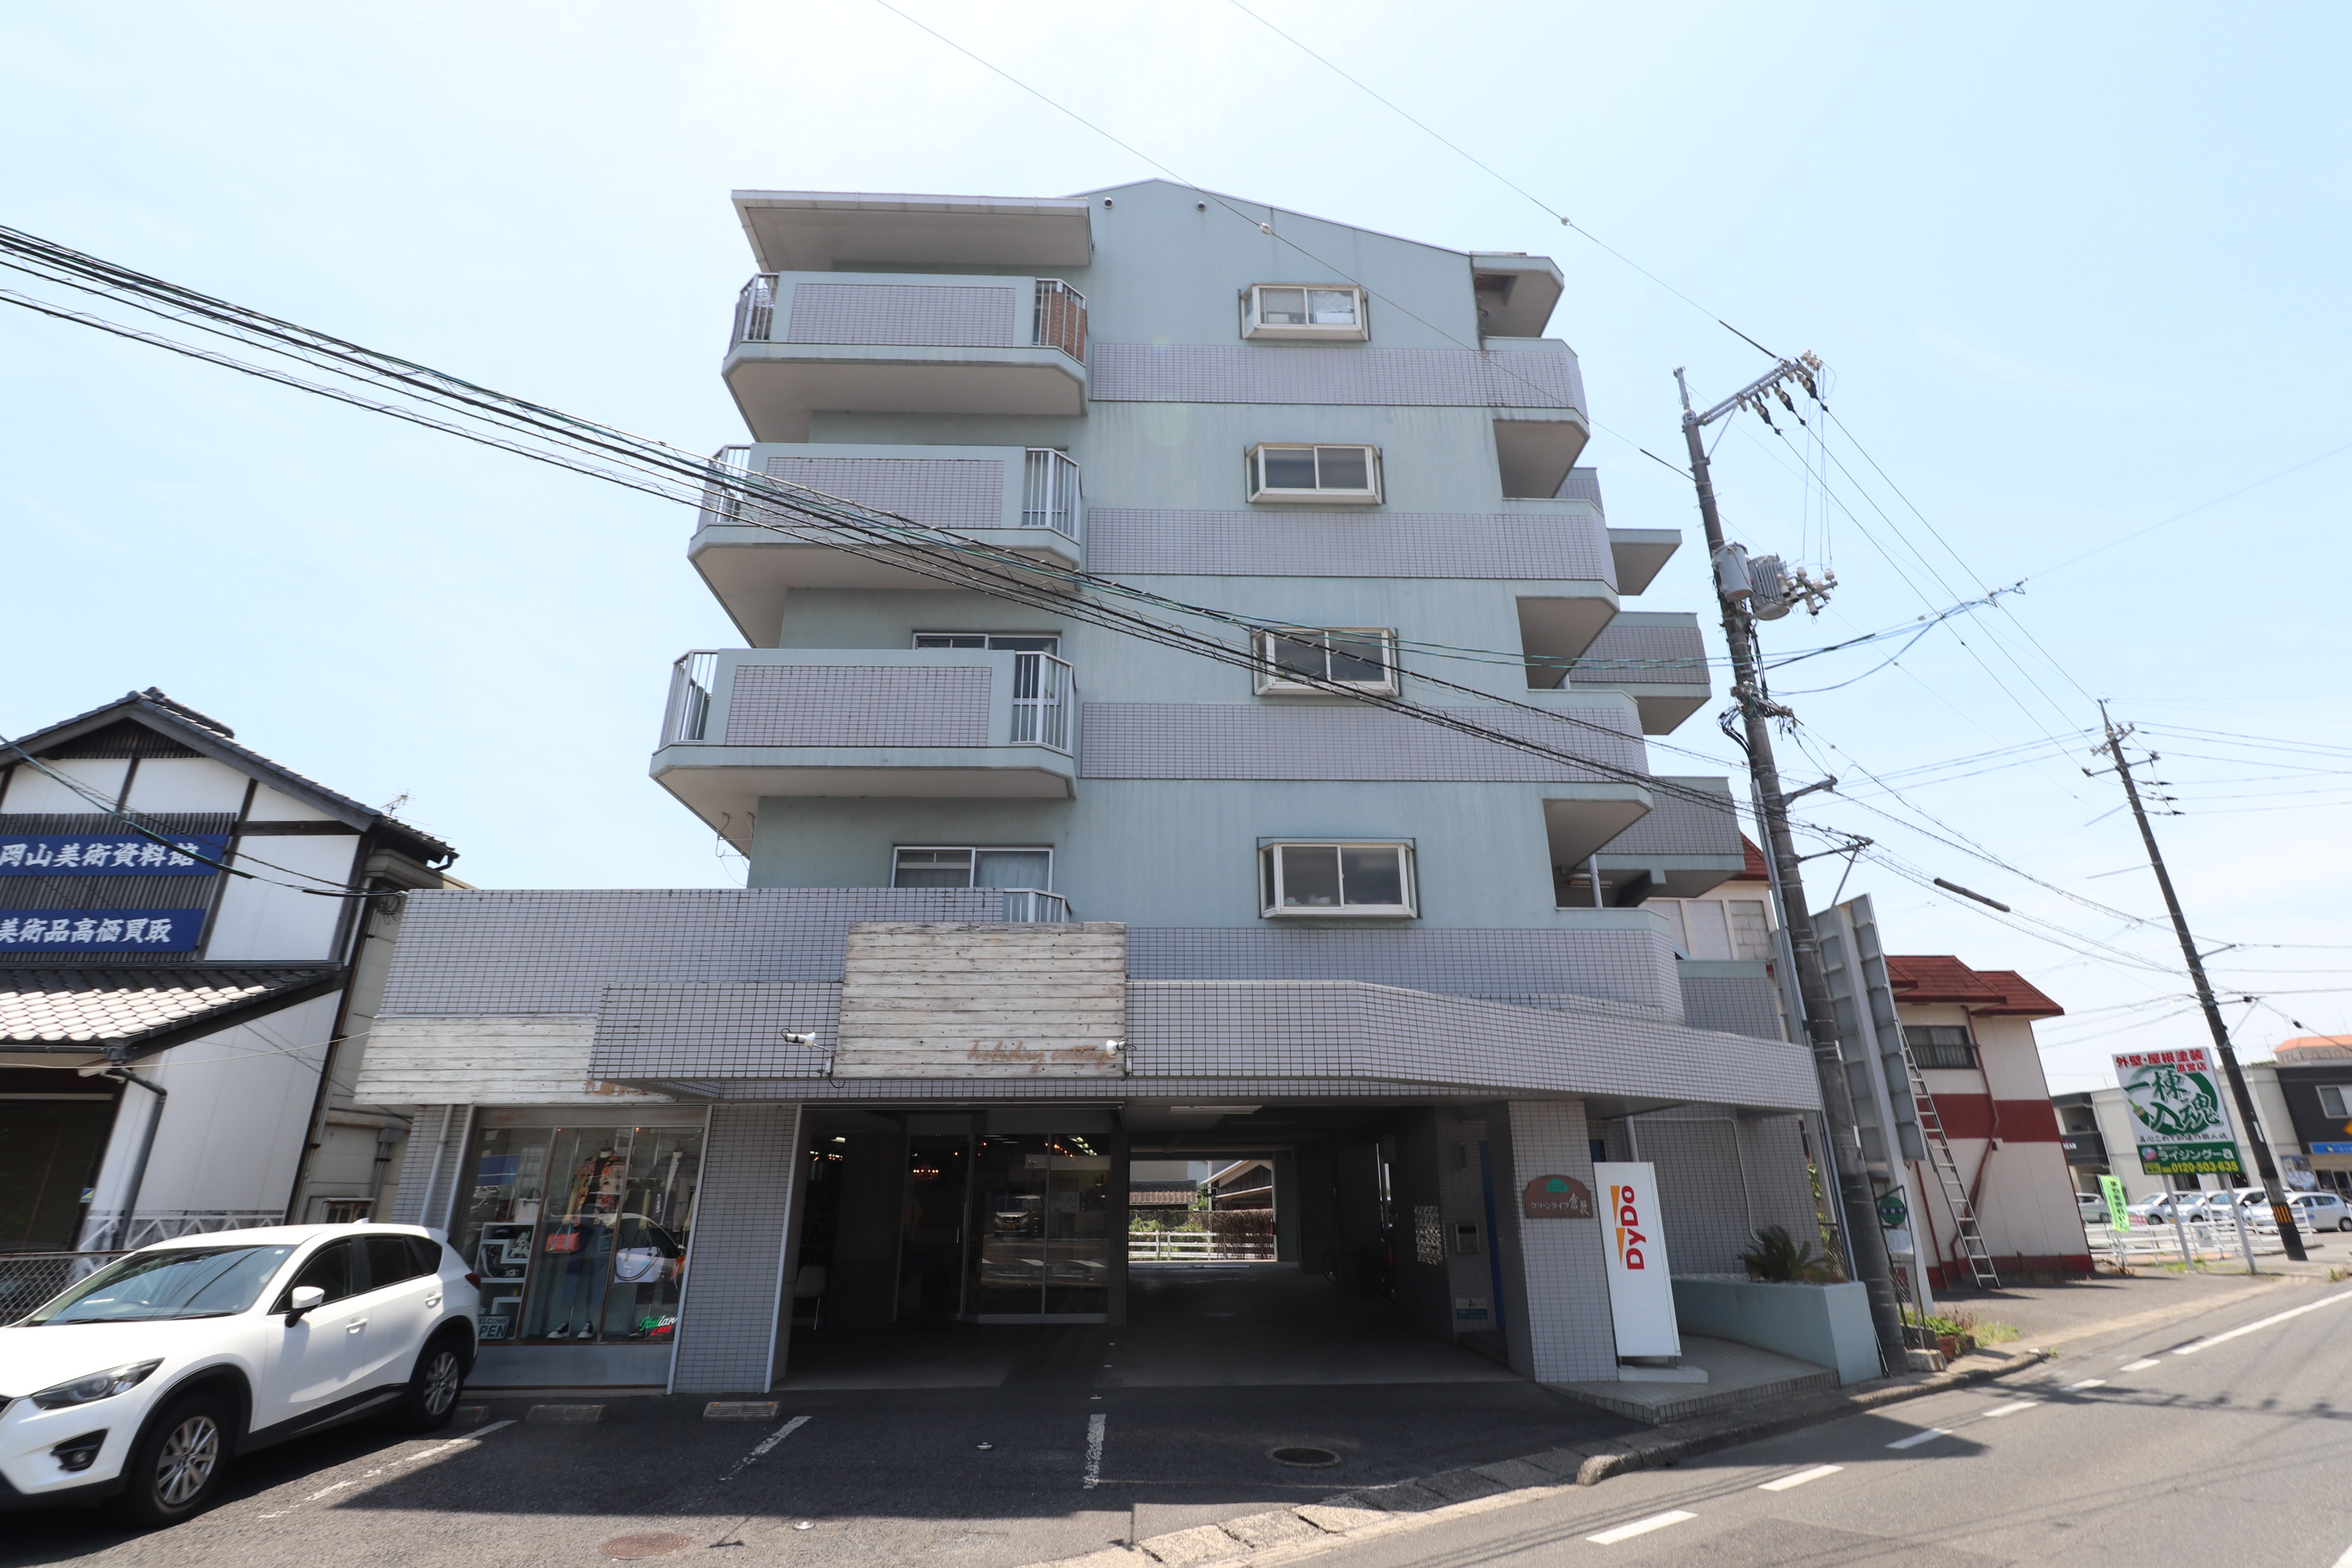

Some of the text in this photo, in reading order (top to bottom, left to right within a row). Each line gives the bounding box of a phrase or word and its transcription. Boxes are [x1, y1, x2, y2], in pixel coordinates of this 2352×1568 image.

[0, 842, 198, 868] 岡山美術資料館
[0, 917, 172, 944] 美術品高価買取
[967, 1040, 1048, 1073] holiday
[2116, 1049, 2205, 1069] 外壁・屋根塗装
[2176, 1062, 2208, 1073] 直営店
[2062, 1142, 2078, 1151] REAM
[2170, 1159, 2240, 1174] 0120-503-635
[1620, 1185, 1647, 1270] DyDo
[478, 1325, 507, 1337] PEN
[639, 1314, 678, 1332] Italian
